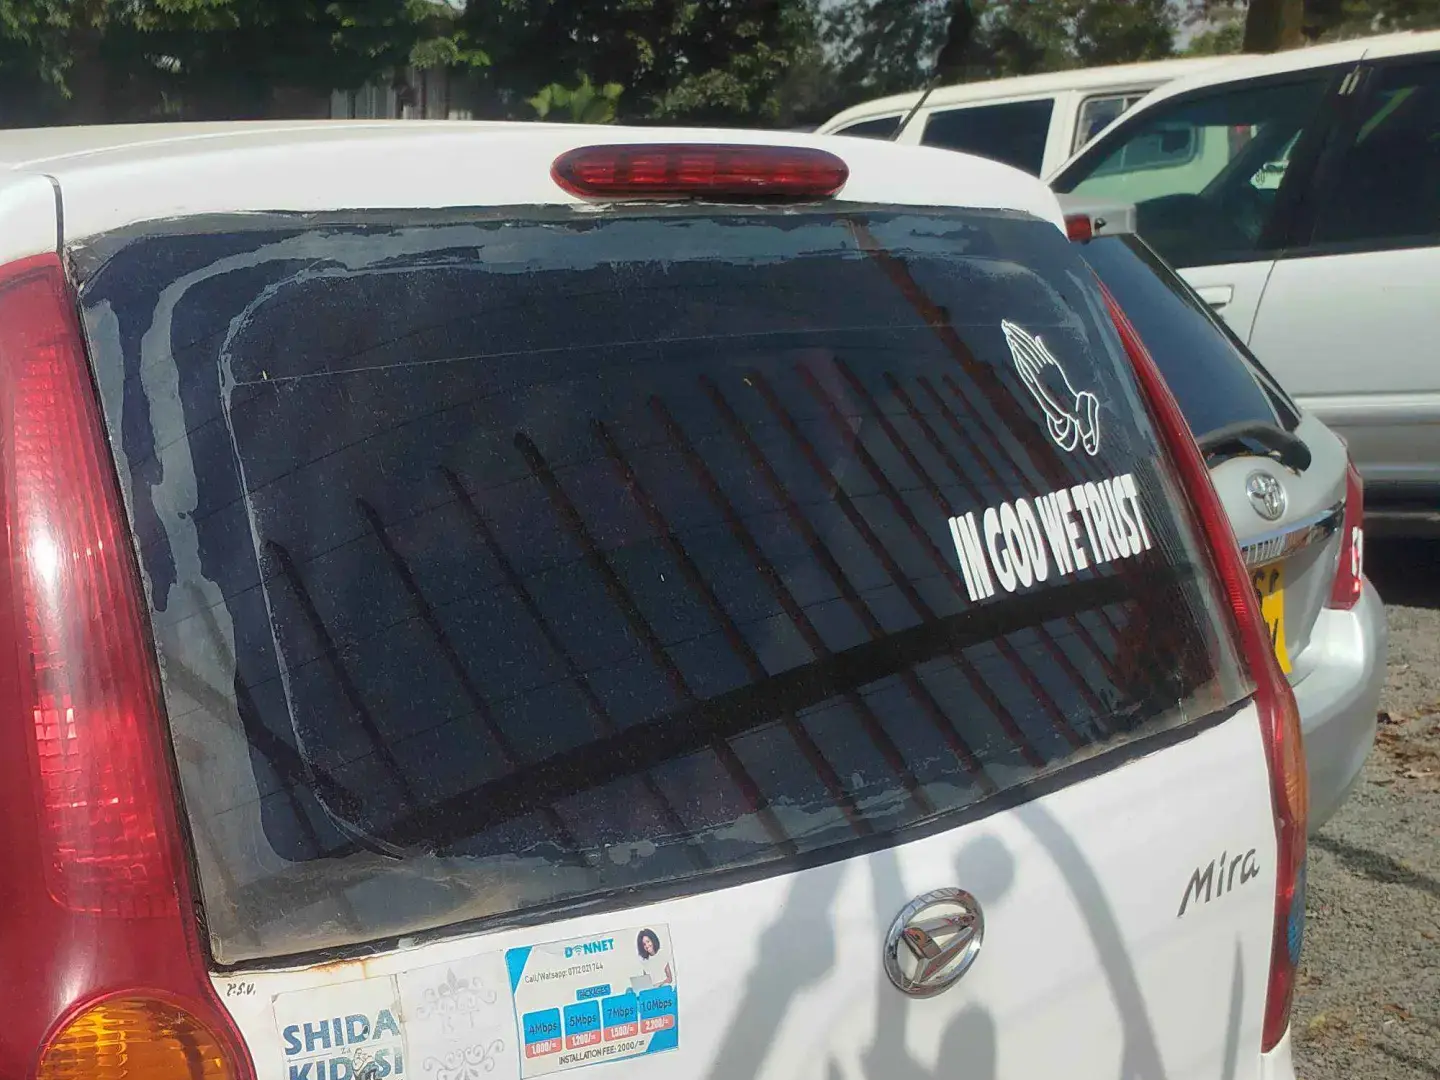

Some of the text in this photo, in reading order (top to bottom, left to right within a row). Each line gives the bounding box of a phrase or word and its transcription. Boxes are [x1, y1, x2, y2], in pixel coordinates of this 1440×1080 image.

[948, 473, 1151, 601] IN GOD WE TRUST
[1177, 848, 1260, 917] Mira
[565, 938, 614, 958] DNNET
[529, 1022, 557, 1034] 4Mbps
[569, 1014, 597, 1027] 5Mbps
[283, 1008, 401, 1055] SHIDA
[559, 1049, 601, 1065] INSTALLATION
